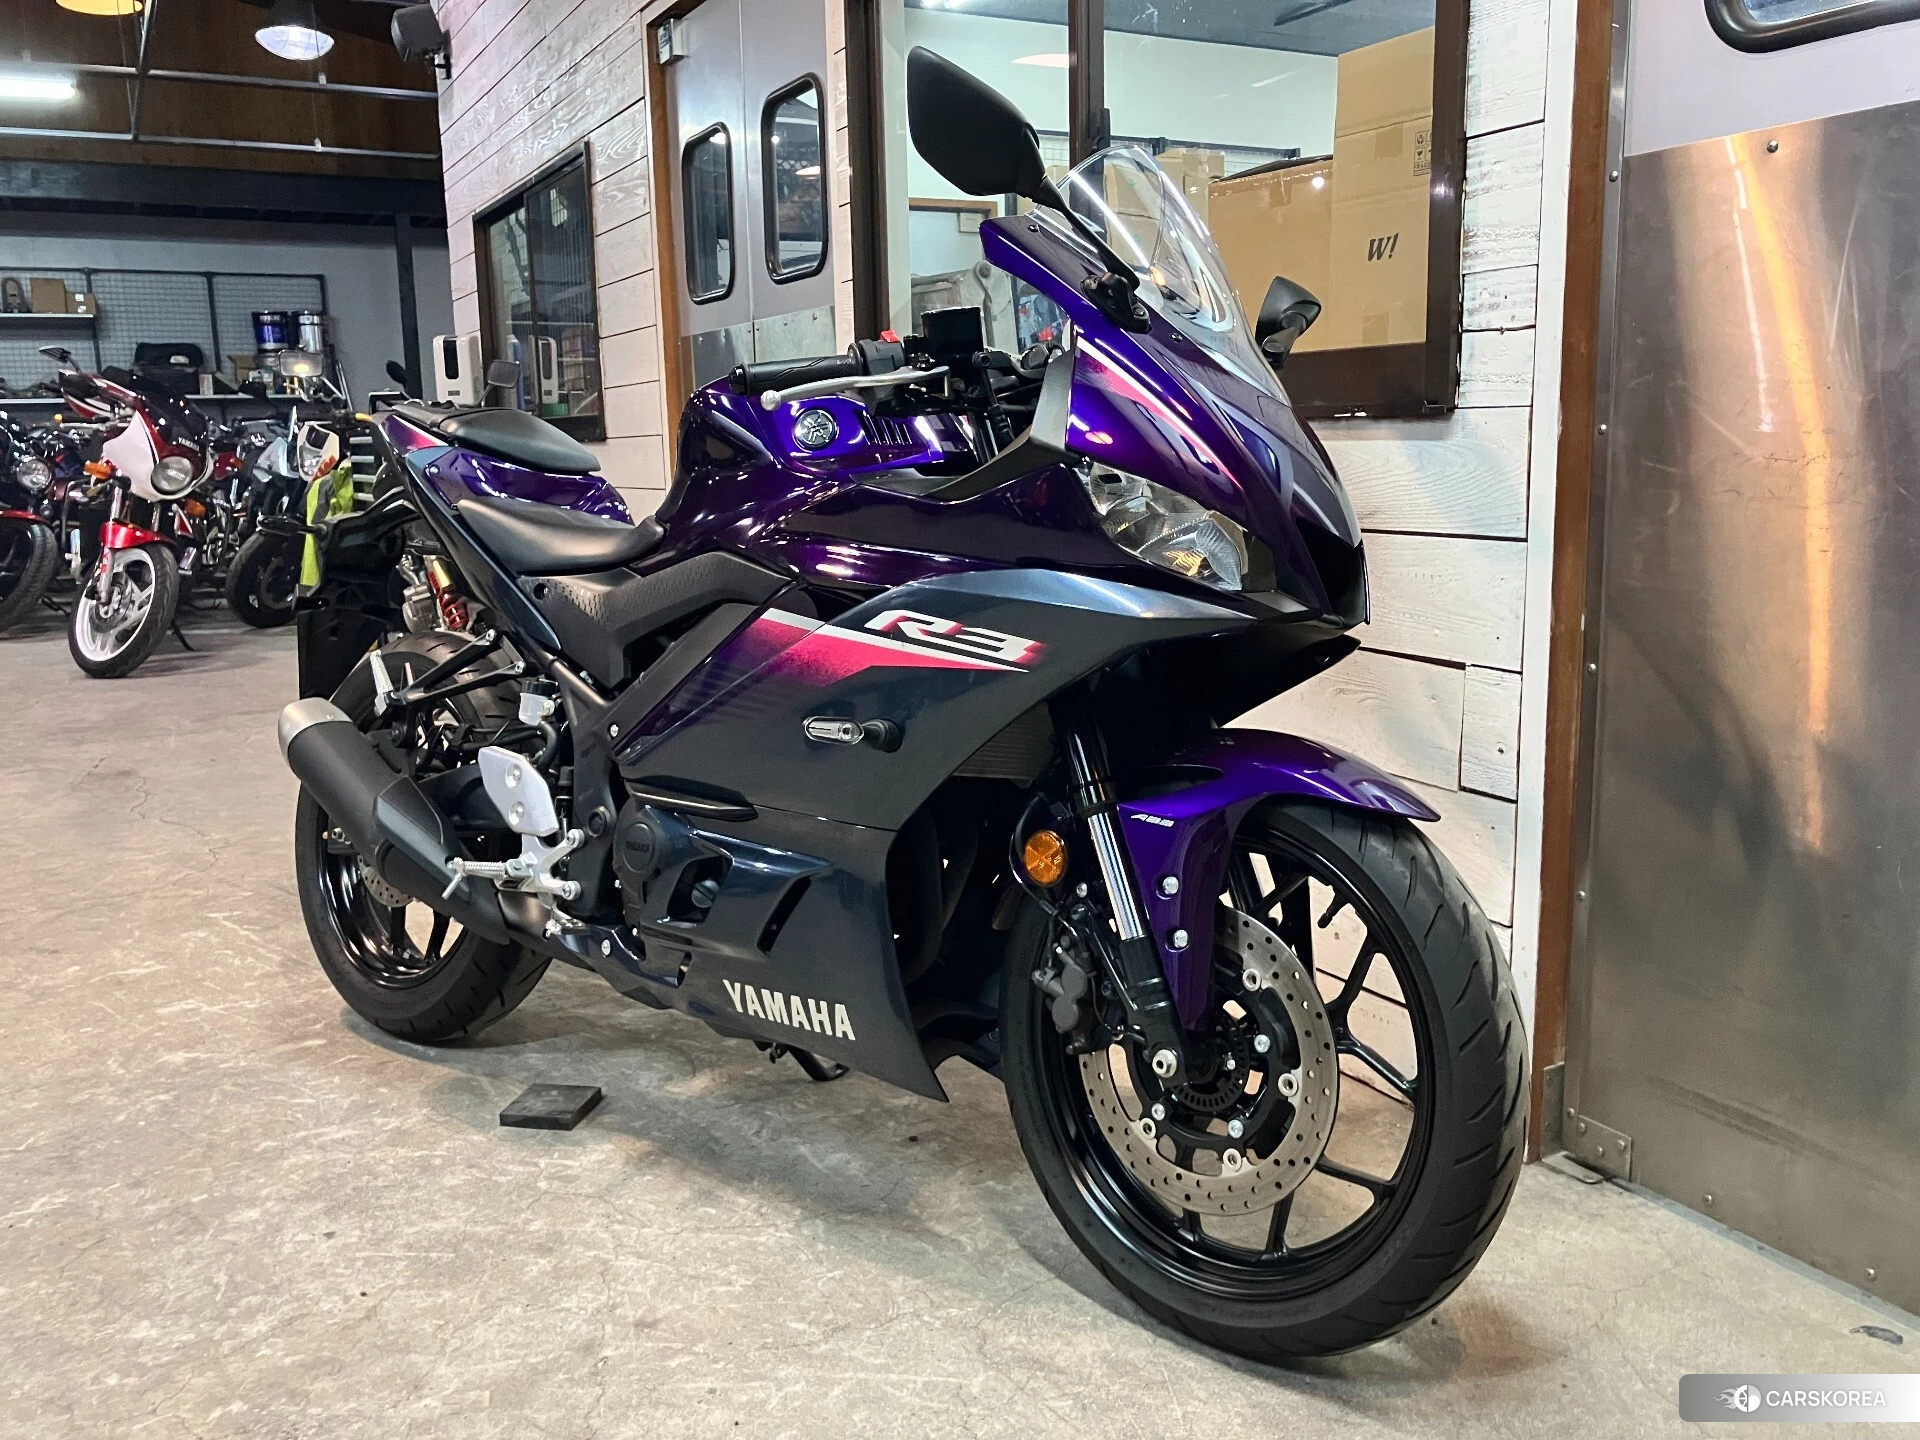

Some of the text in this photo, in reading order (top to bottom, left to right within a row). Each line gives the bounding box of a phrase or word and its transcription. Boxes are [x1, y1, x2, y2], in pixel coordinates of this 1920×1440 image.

[1368, 232, 1399, 262] W!
[864, 610, 1042, 663] R3
[1131, 813, 1175, 828] ABS
[722, 979, 856, 1041] YAMAHA
